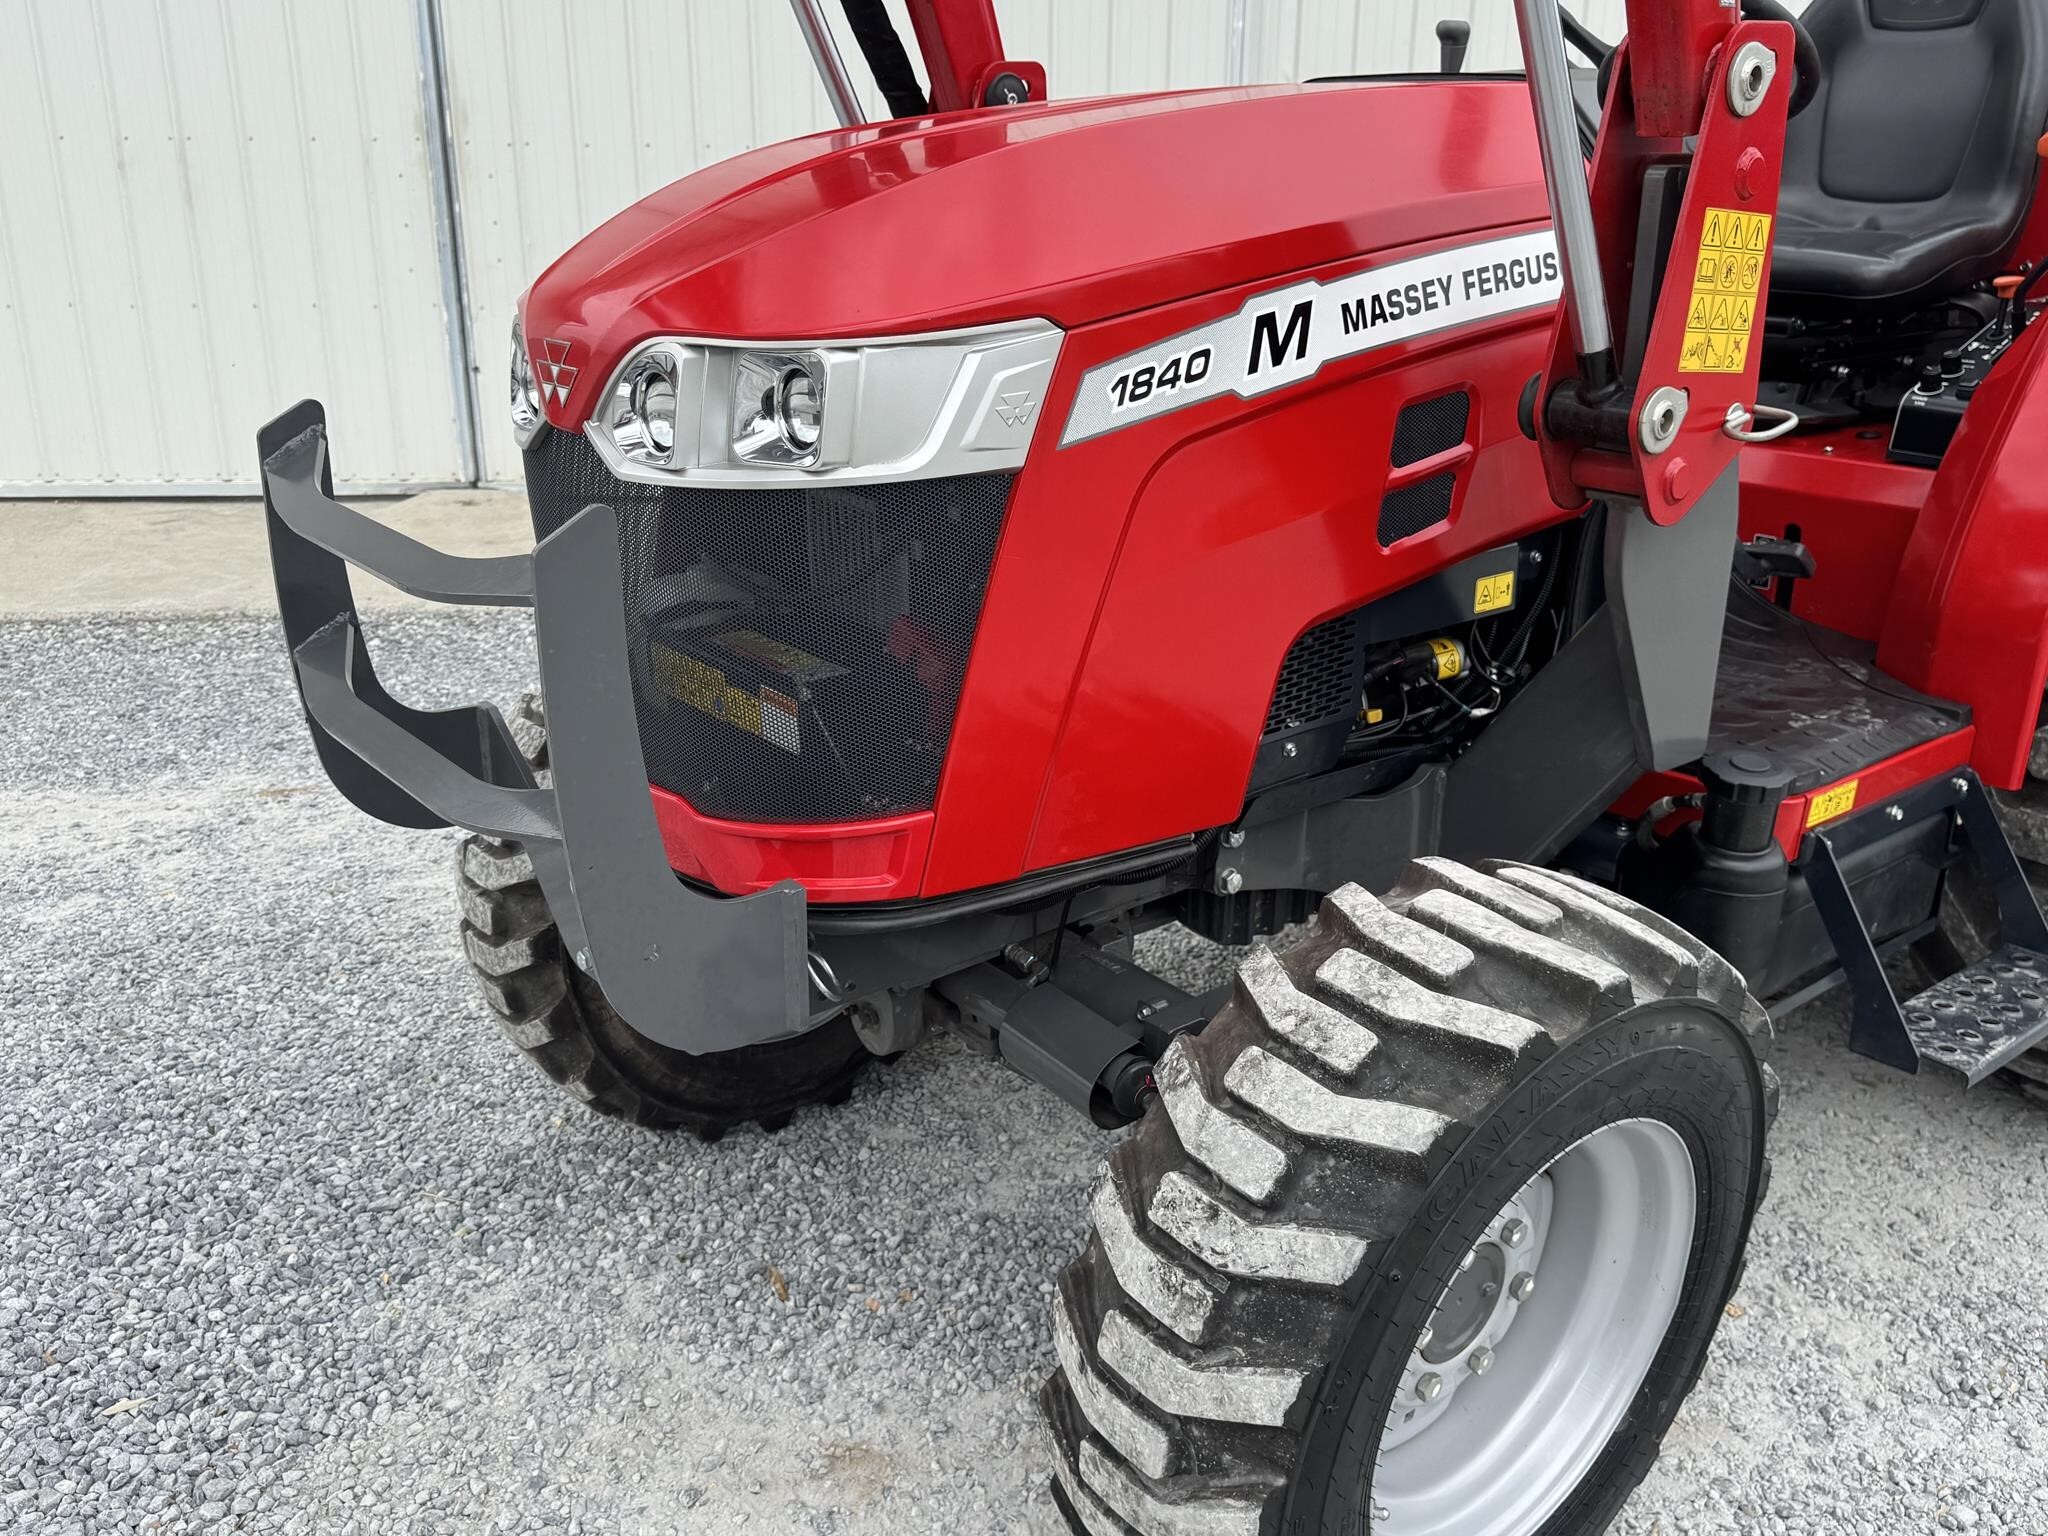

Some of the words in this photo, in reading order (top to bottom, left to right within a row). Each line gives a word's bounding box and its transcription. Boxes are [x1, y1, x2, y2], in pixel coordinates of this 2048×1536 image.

[1110, 347, 1212, 407] 1840
[1247, 300, 1313, 375] M
[1341, 274, 1453, 335] MASSEY
[1462, 252, 1558, 301] FERGUS
